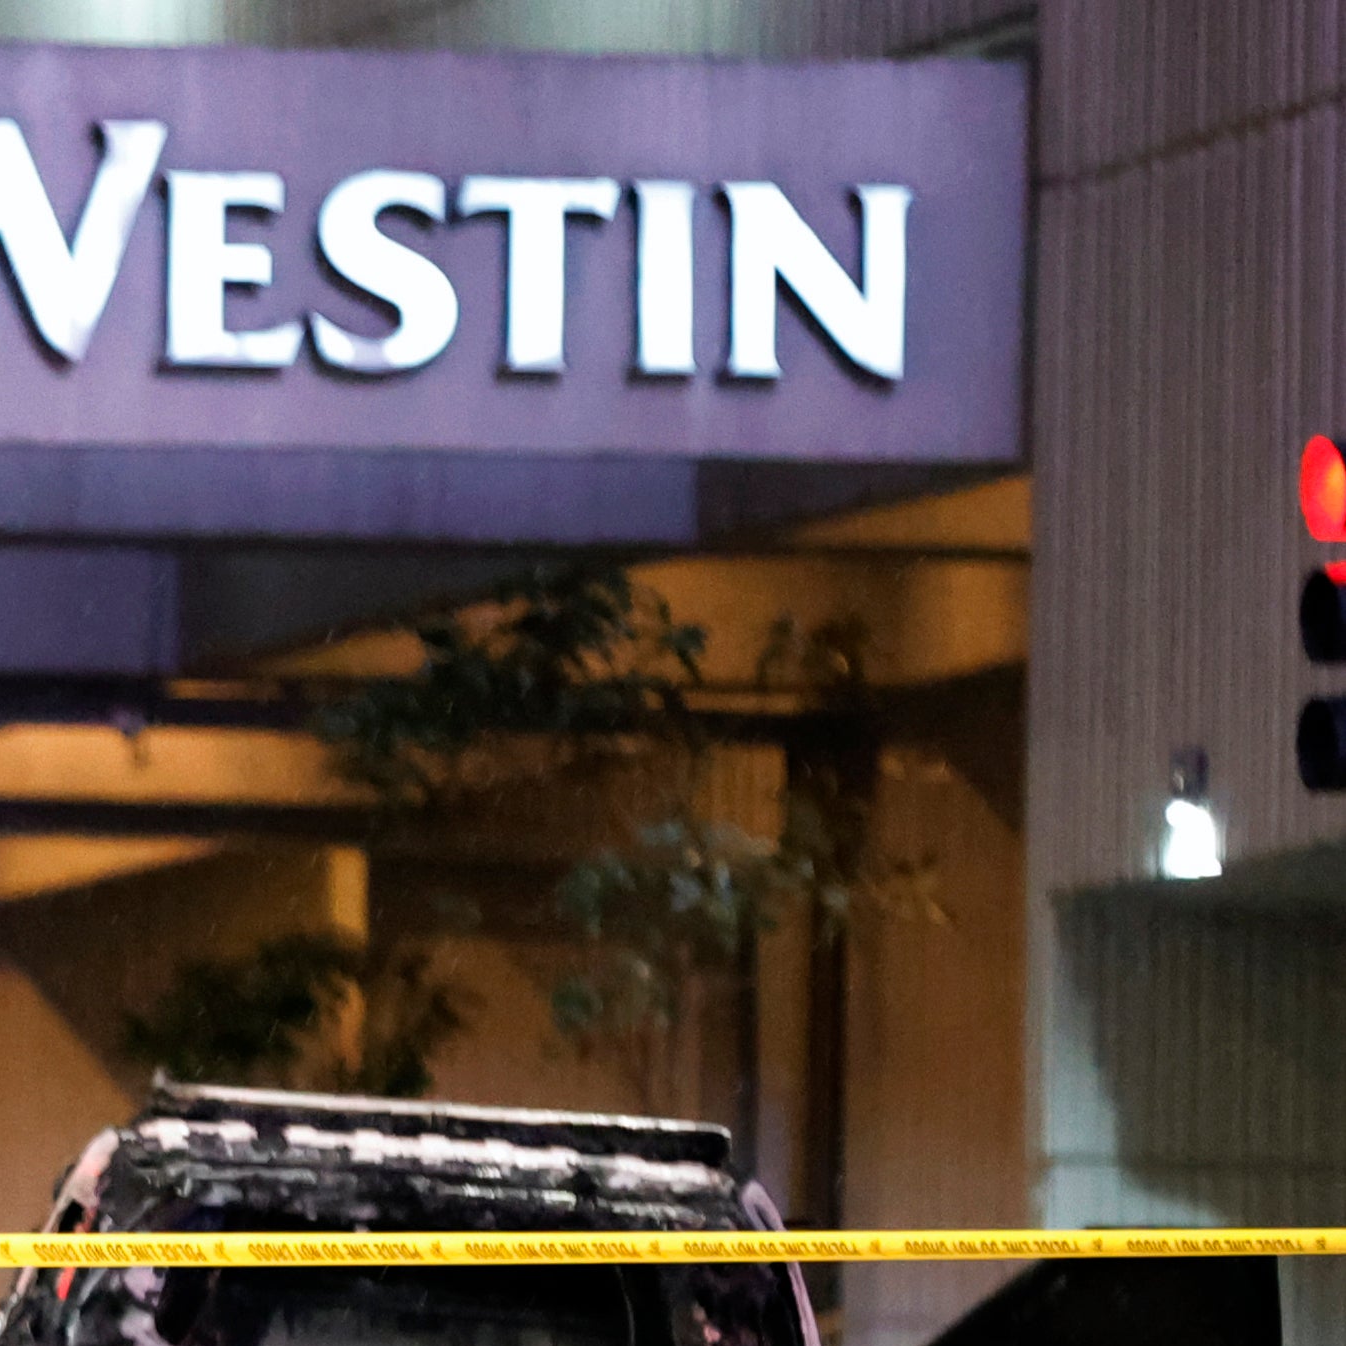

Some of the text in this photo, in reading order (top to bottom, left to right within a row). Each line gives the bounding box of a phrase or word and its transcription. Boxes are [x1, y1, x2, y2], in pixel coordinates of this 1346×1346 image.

[33, 1243, 79, 1262] CROSS
[79, 1243, 108, 1262] NOT
[127, 1243, 159, 1262] LINE
[158, 1243, 207, 1262] POLICE
[248, 1243, 294, 1261] CROSS
[294, 1243, 324, 1261] NOT
[342, 1243, 375, 1261] LINE
[374, 1243, 424, 1261] POLICE
